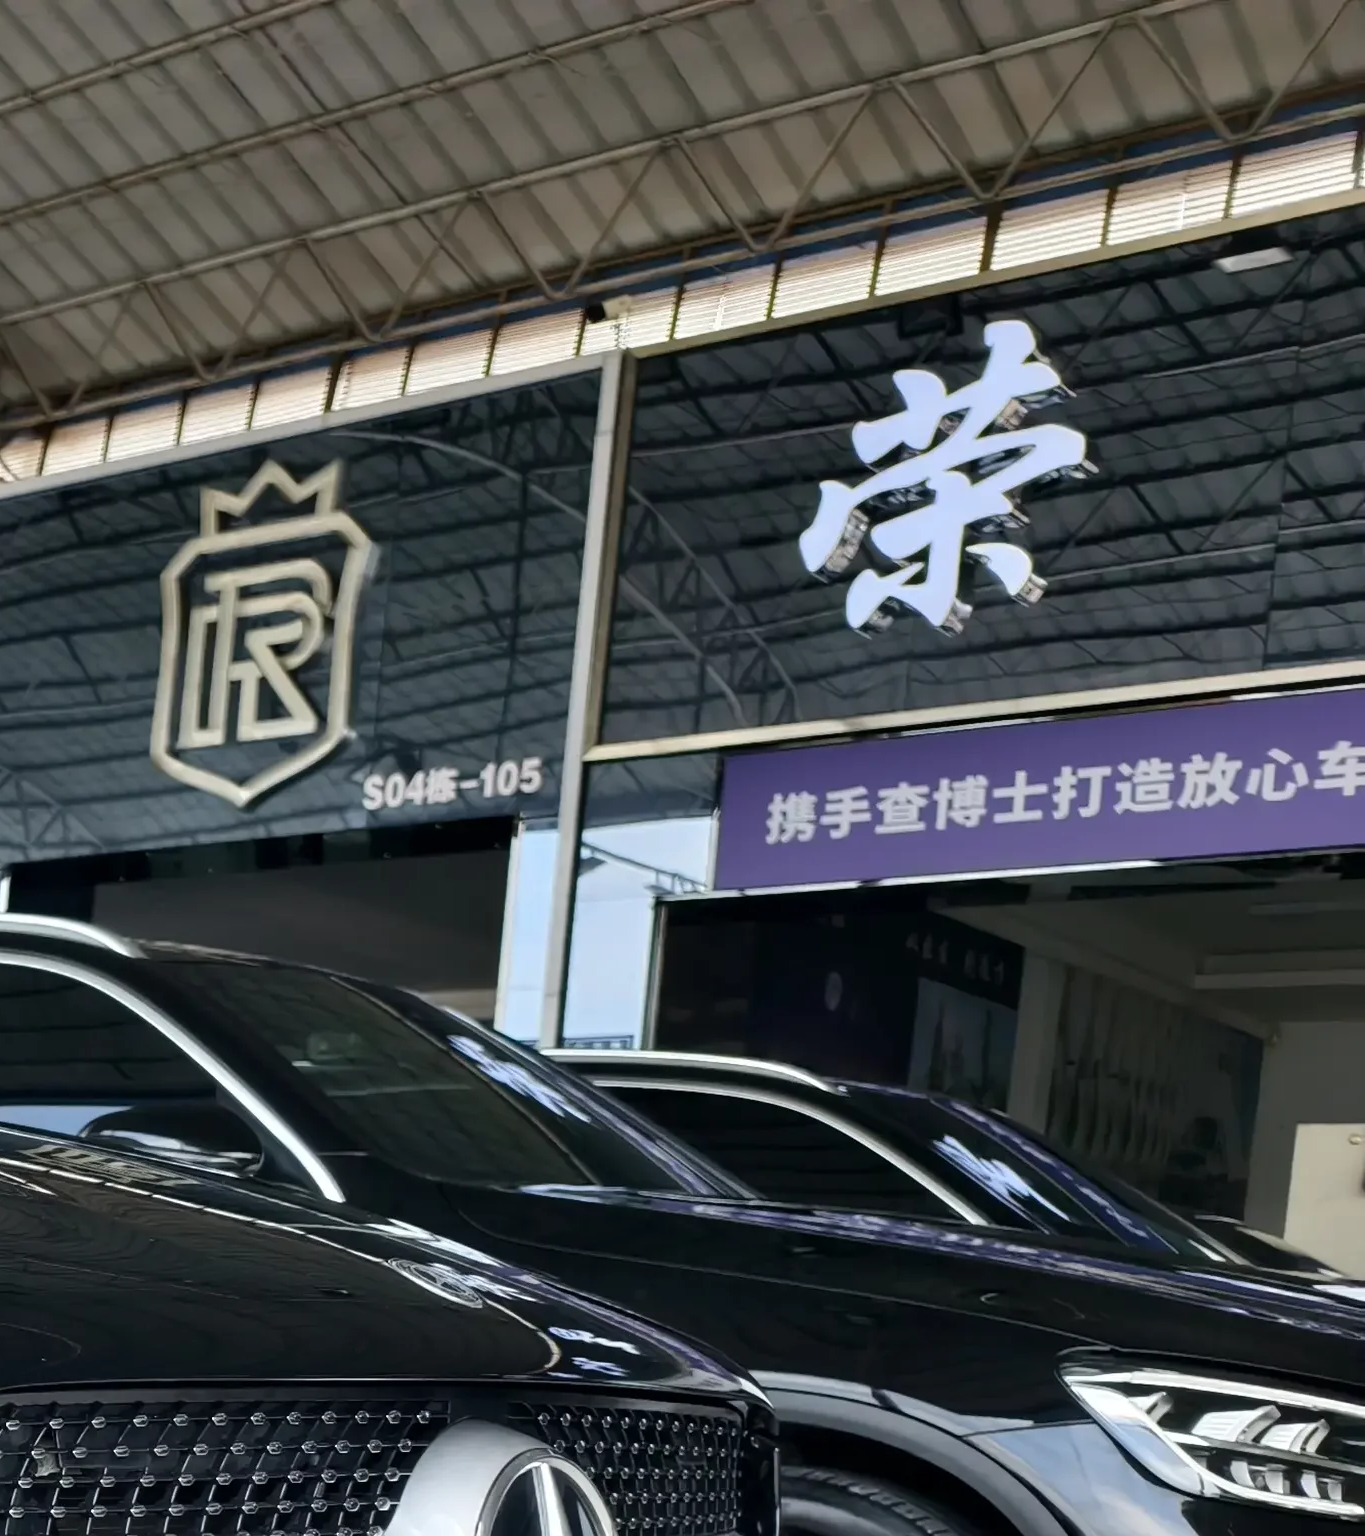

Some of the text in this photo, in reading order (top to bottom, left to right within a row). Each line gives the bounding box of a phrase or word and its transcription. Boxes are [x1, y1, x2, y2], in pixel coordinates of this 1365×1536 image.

[799, 320, 1089, 632] 荣
[765, 741, 1365, 844] 携手查博士打造放心车
